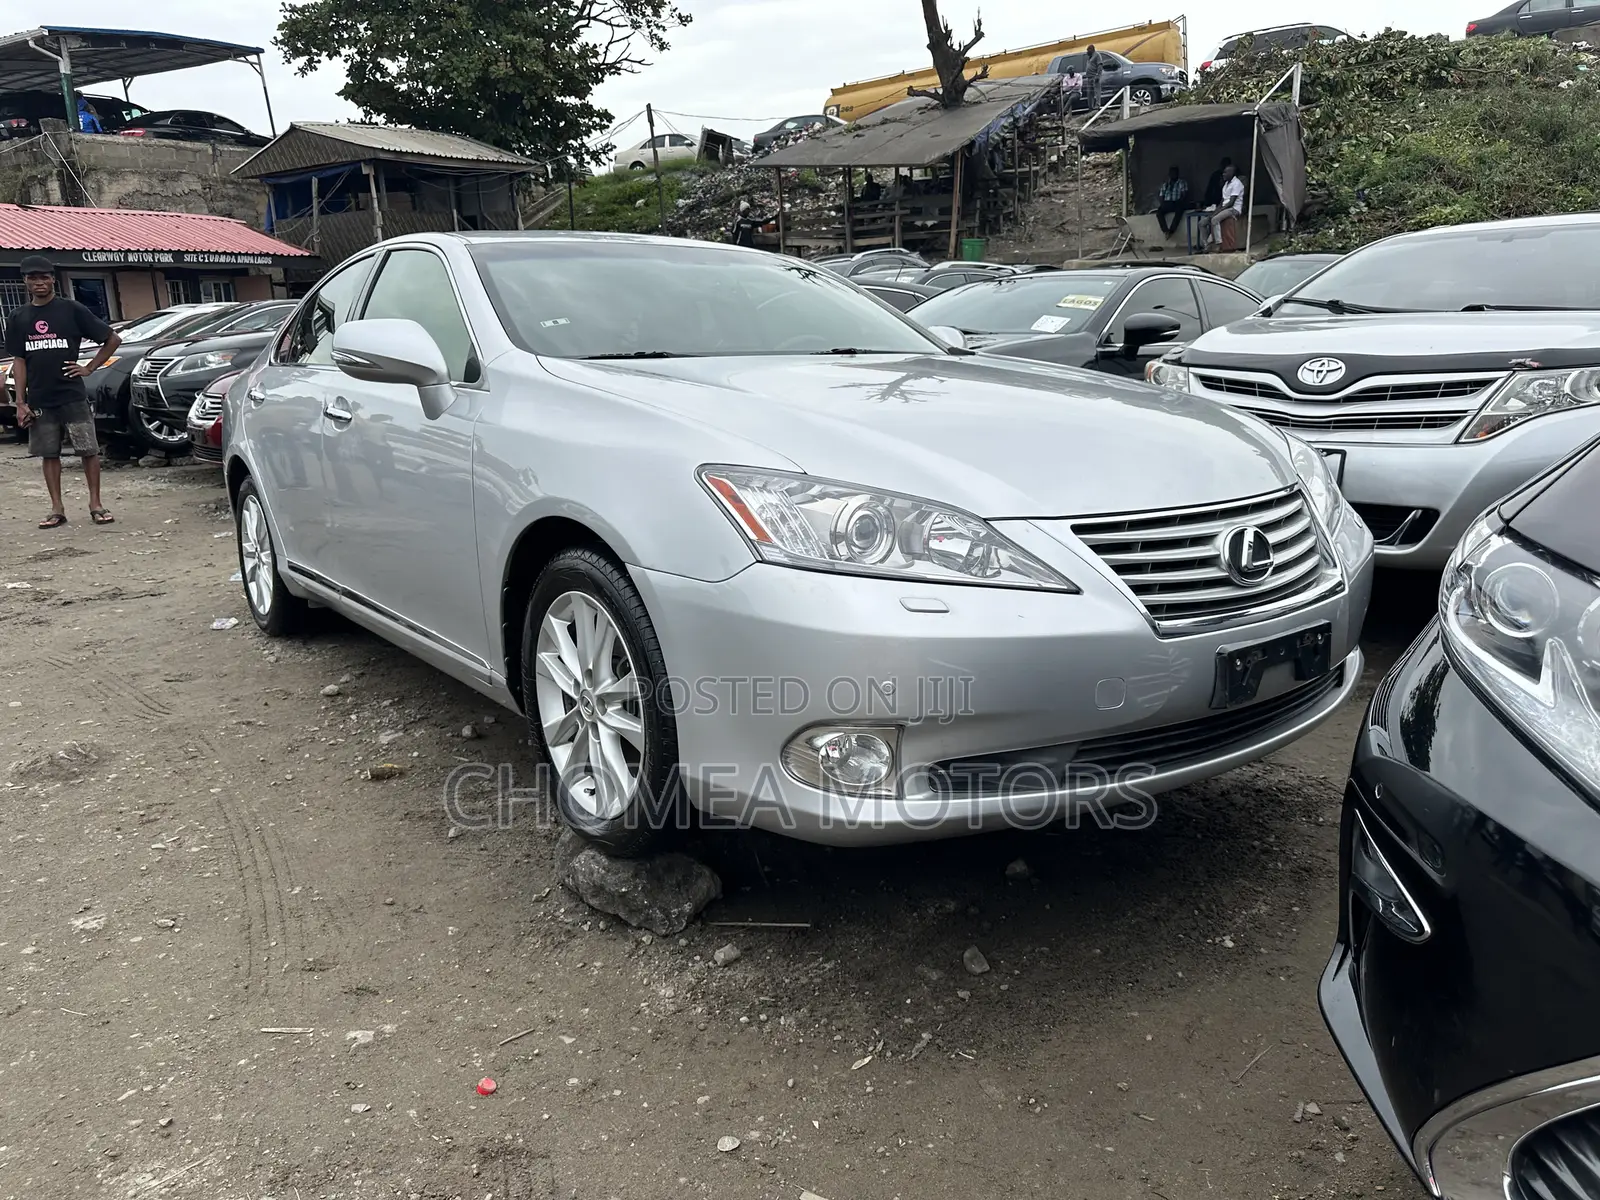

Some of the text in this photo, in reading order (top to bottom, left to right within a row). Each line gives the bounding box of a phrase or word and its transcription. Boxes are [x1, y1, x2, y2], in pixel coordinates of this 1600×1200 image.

[82, 251, 124, 262] CLEARWAY
[127, 252, 153, 262] MOTOR
[154, 252, 174, 263] PARK
[254, 256, 272, 265] LAGOS
[1062, 298, 1099, 307] LAGOS
